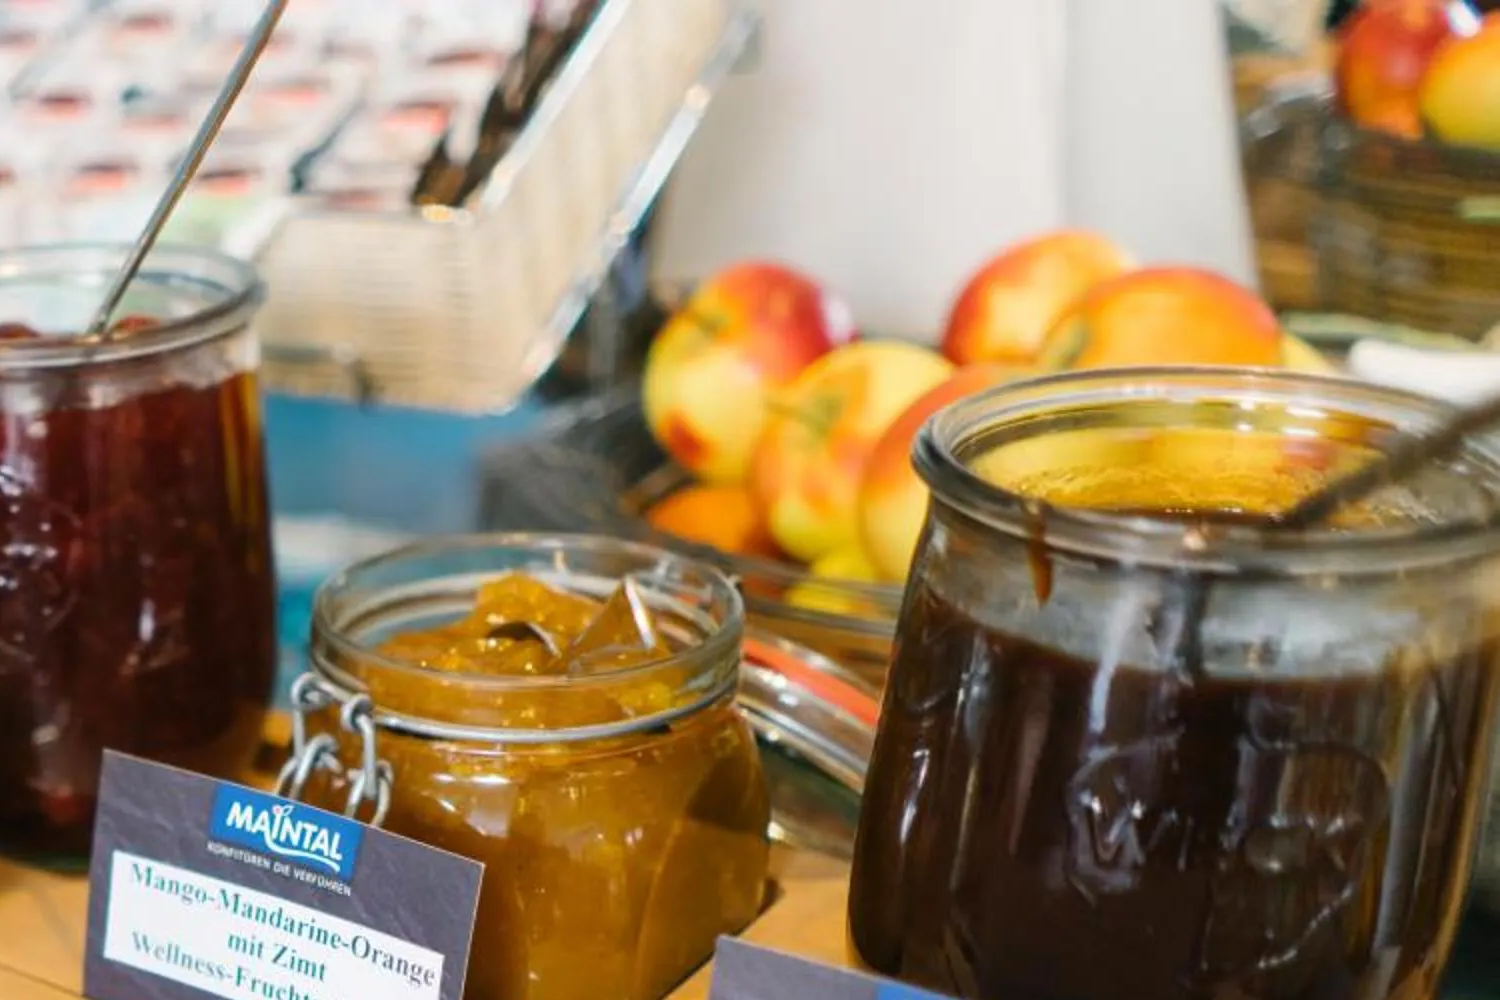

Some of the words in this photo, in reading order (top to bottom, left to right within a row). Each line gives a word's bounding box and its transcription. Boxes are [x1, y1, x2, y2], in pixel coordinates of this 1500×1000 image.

[226, 802, 343, 872] MAINTAL
[273, 861, 291, 877] DIE
[130, 862, 436, 988] Mango-Mandarine-Orange
[228, 931, 264, 959] mit
[270, 942, 327, 983] Zimt
